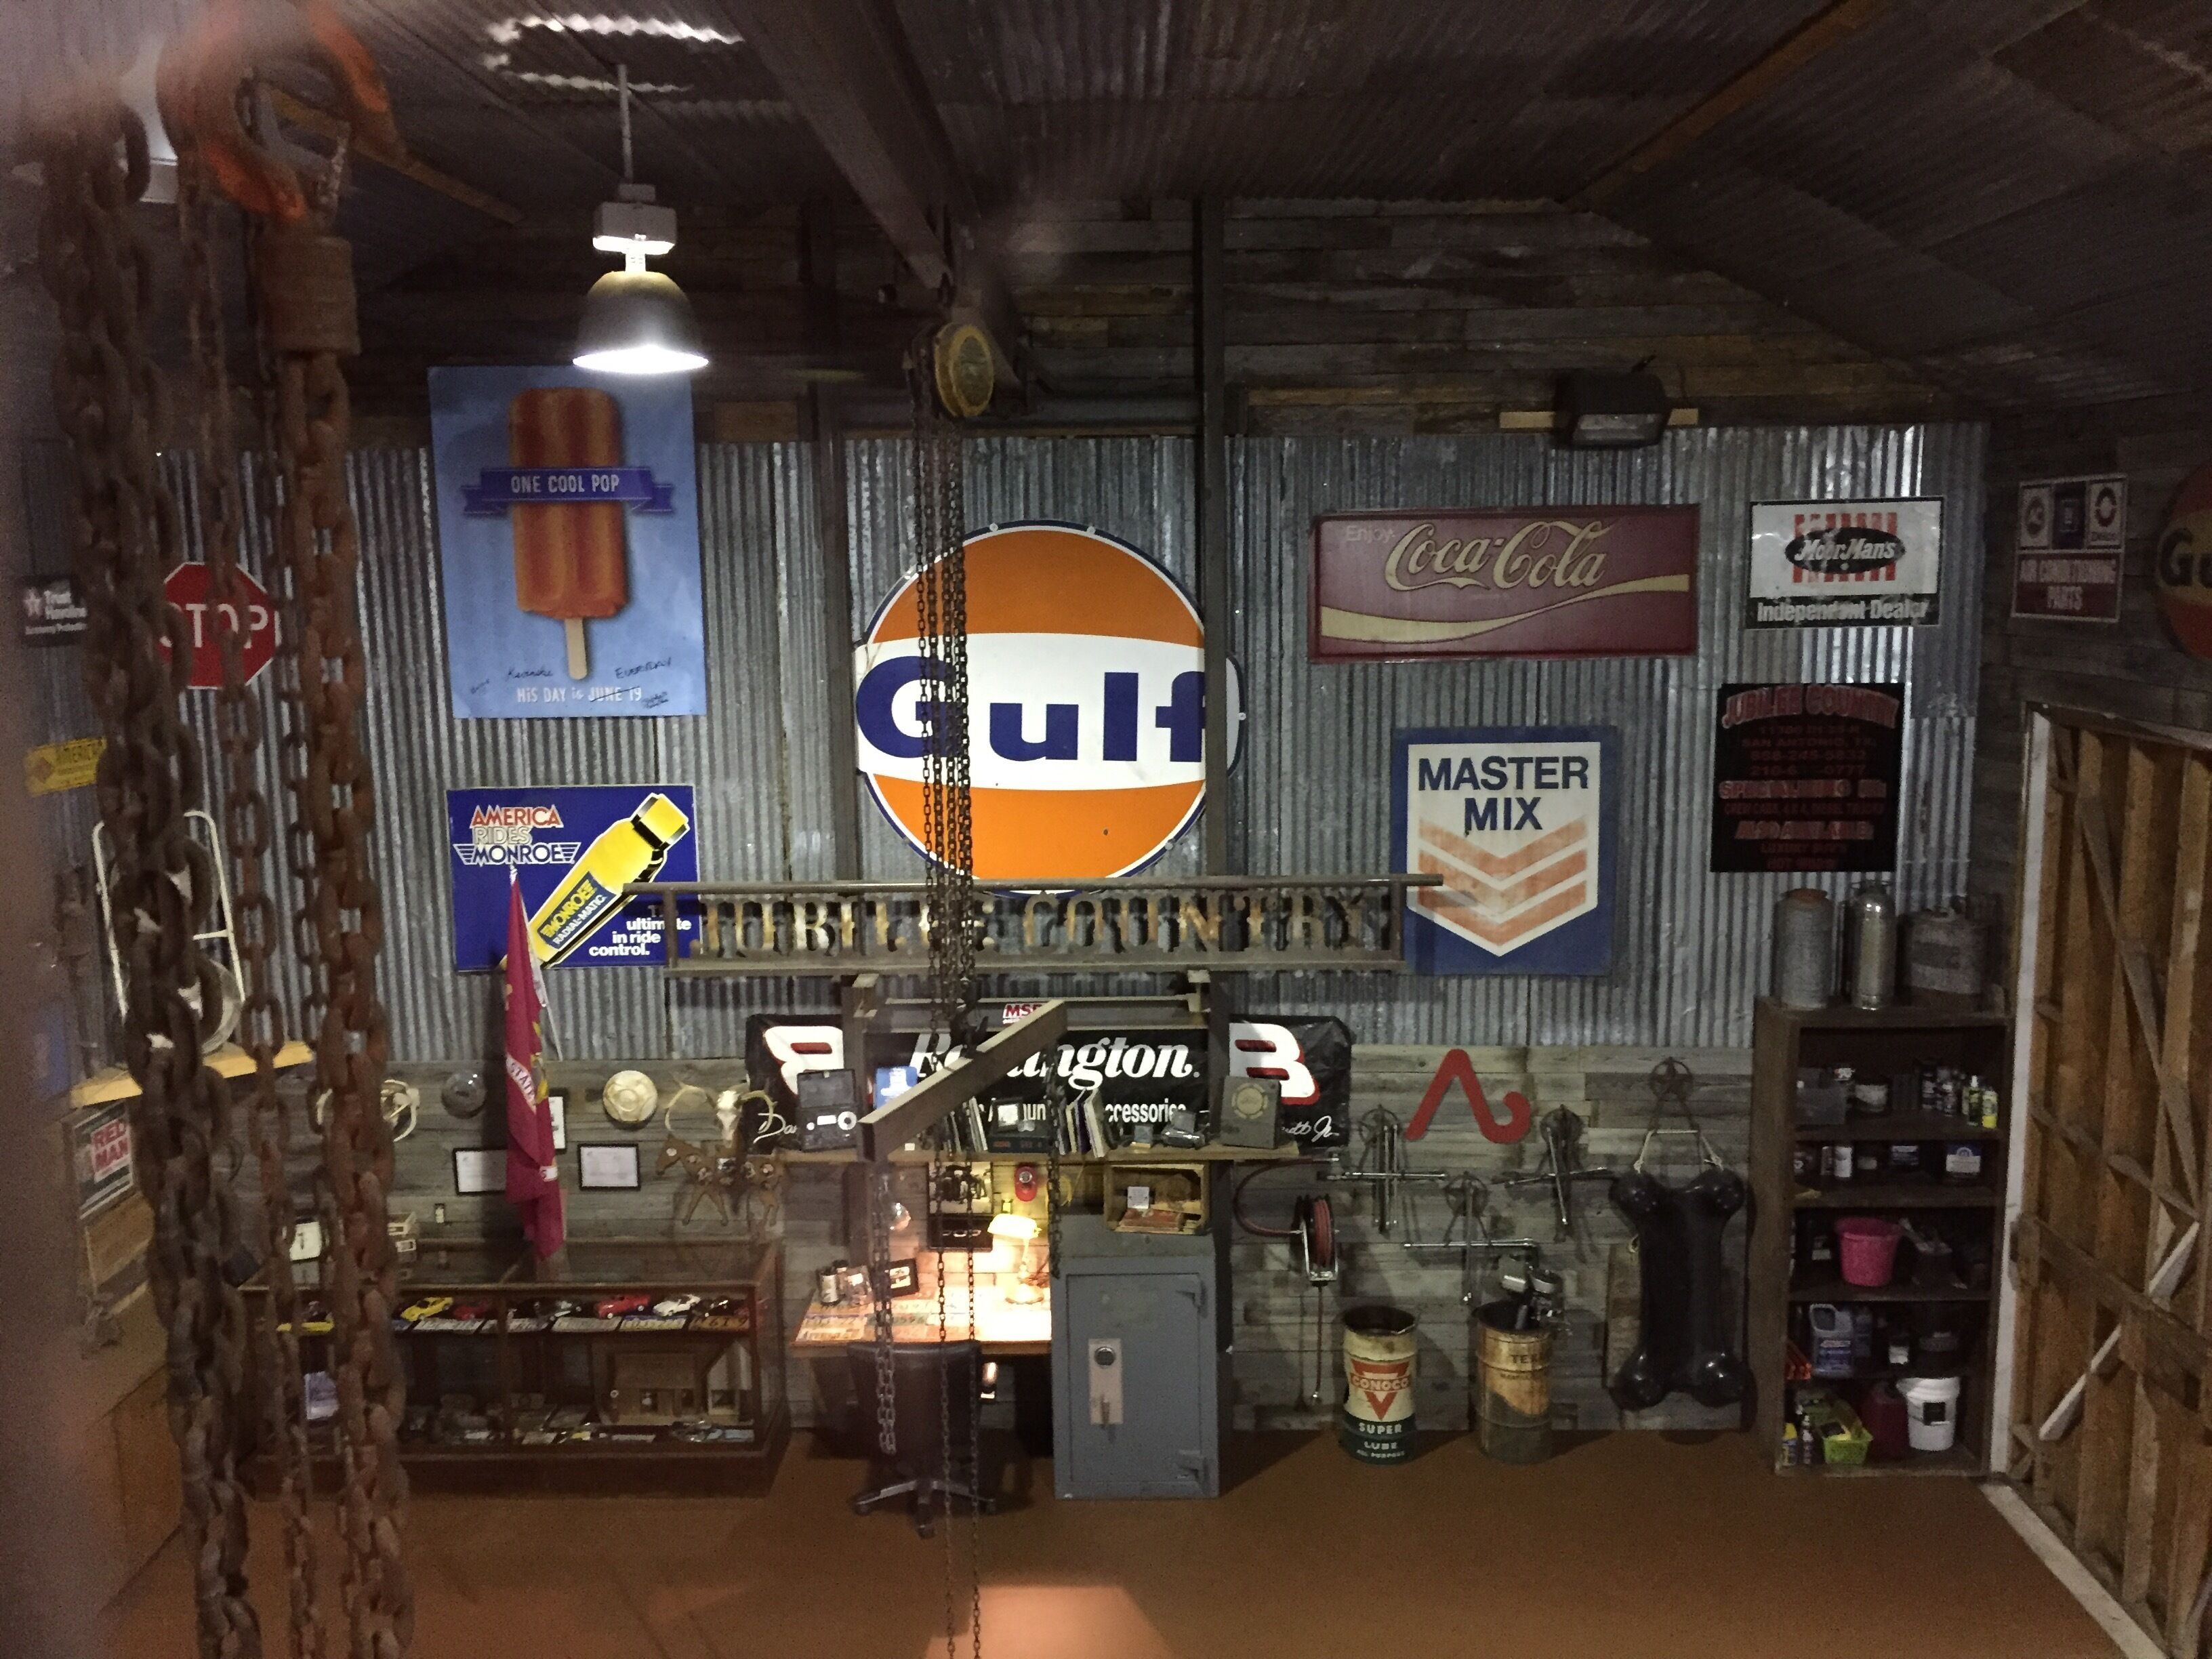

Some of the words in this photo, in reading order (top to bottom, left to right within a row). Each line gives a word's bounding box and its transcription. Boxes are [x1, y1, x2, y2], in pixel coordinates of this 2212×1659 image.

[510, 476, 541, 493] ONE
[548, 475, 585, 493] COOL
[592, 474, 620, 492] POP
[1346, 525, 1391, 544] Enjoy
[1384, 520, 1614, 592] Coca-Cola
[1870, 598, 1930, 619] Dealer
[159, 602, 268, 649] TP
[543, 687, 567, 703] DAY
[588, 686, 623, 702] JUNE
[855, 655, 1207, 762] Gulf
[1418, 756, 1589, 791] MASTER
[471, 804, 563, 827] AMERICA
[1464, 797, 1543, 832] MIX
[474, 827, 531, 844] RIDES
[474, 844, 563, 864] MONROE
[541, 880, 596, 938] MONROE
[626, 917, 693, 930] ultimte
[612, 930, 628, 944] in
[629, 930, 661, 944] ride
[588, 942, 651, 956] control.
[1351, 1375, 1410, 1391] CONOCO
[1358, 1422, 1402, 1435] SUPER
